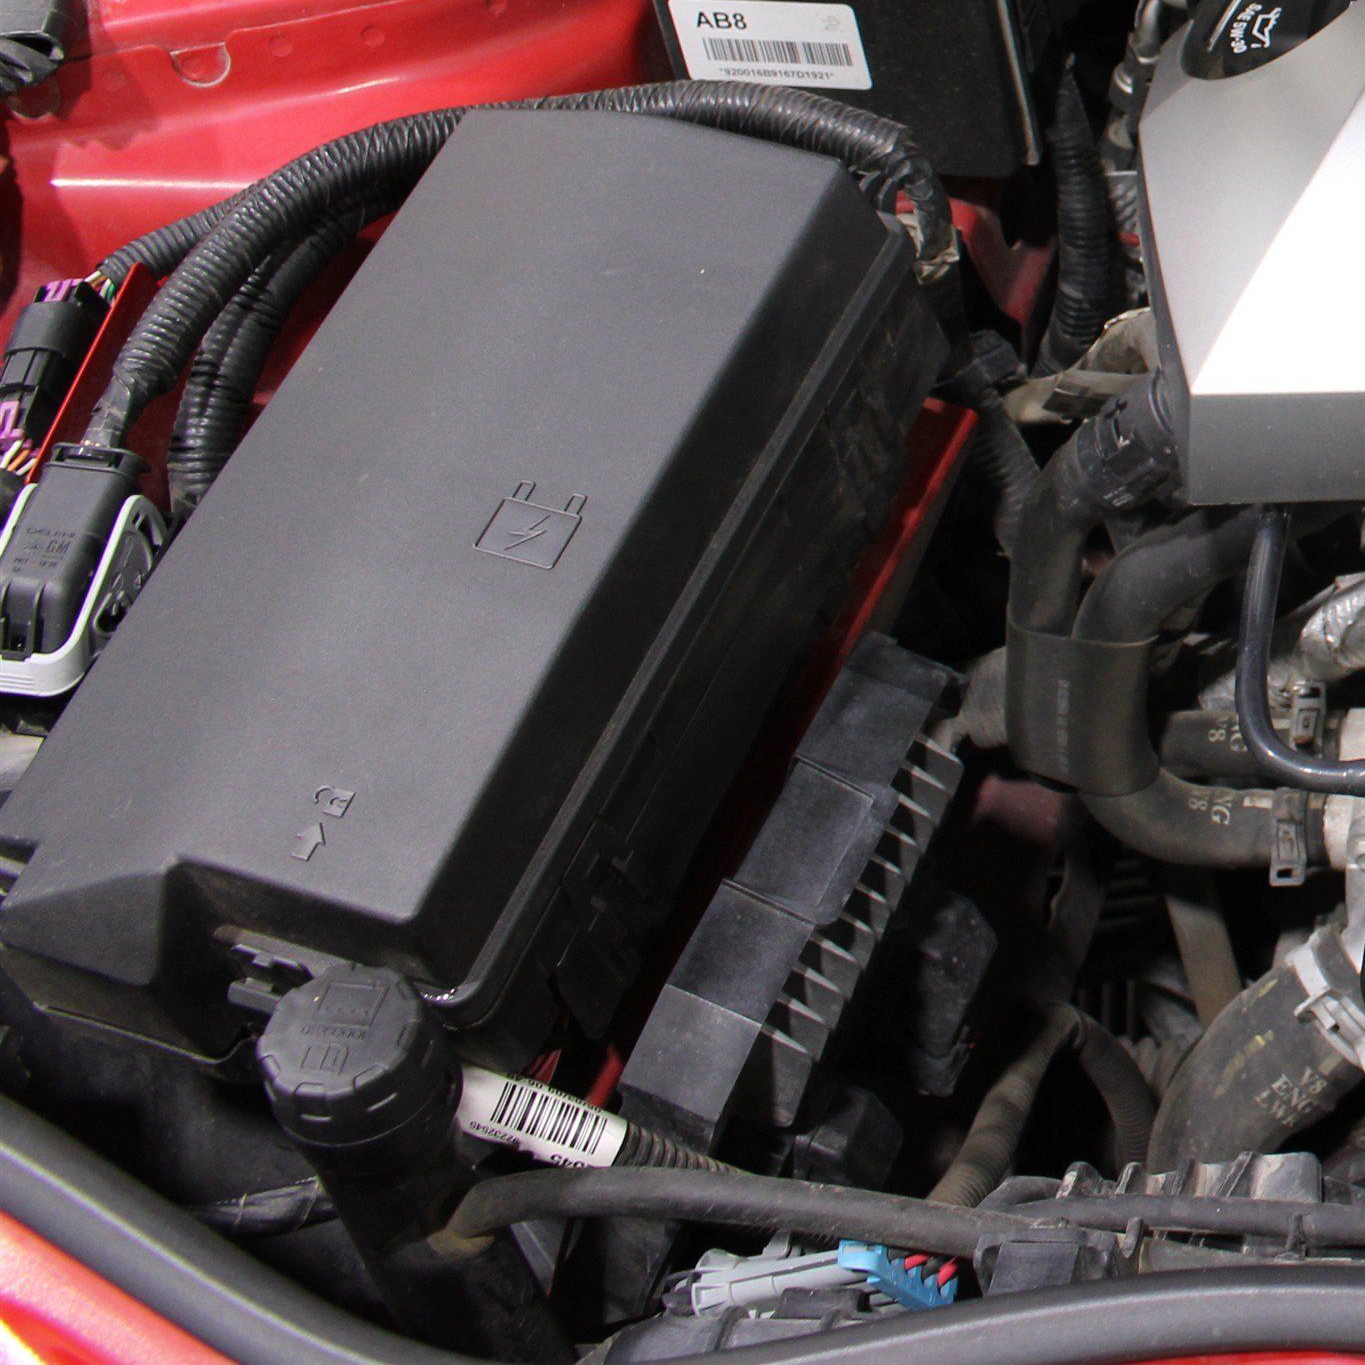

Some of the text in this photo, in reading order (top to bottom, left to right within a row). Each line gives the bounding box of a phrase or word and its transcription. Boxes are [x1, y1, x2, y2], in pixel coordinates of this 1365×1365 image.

[696, 10, 748, 30] AB8
[1229, 2, 1263, 54] SAE 5W-30
